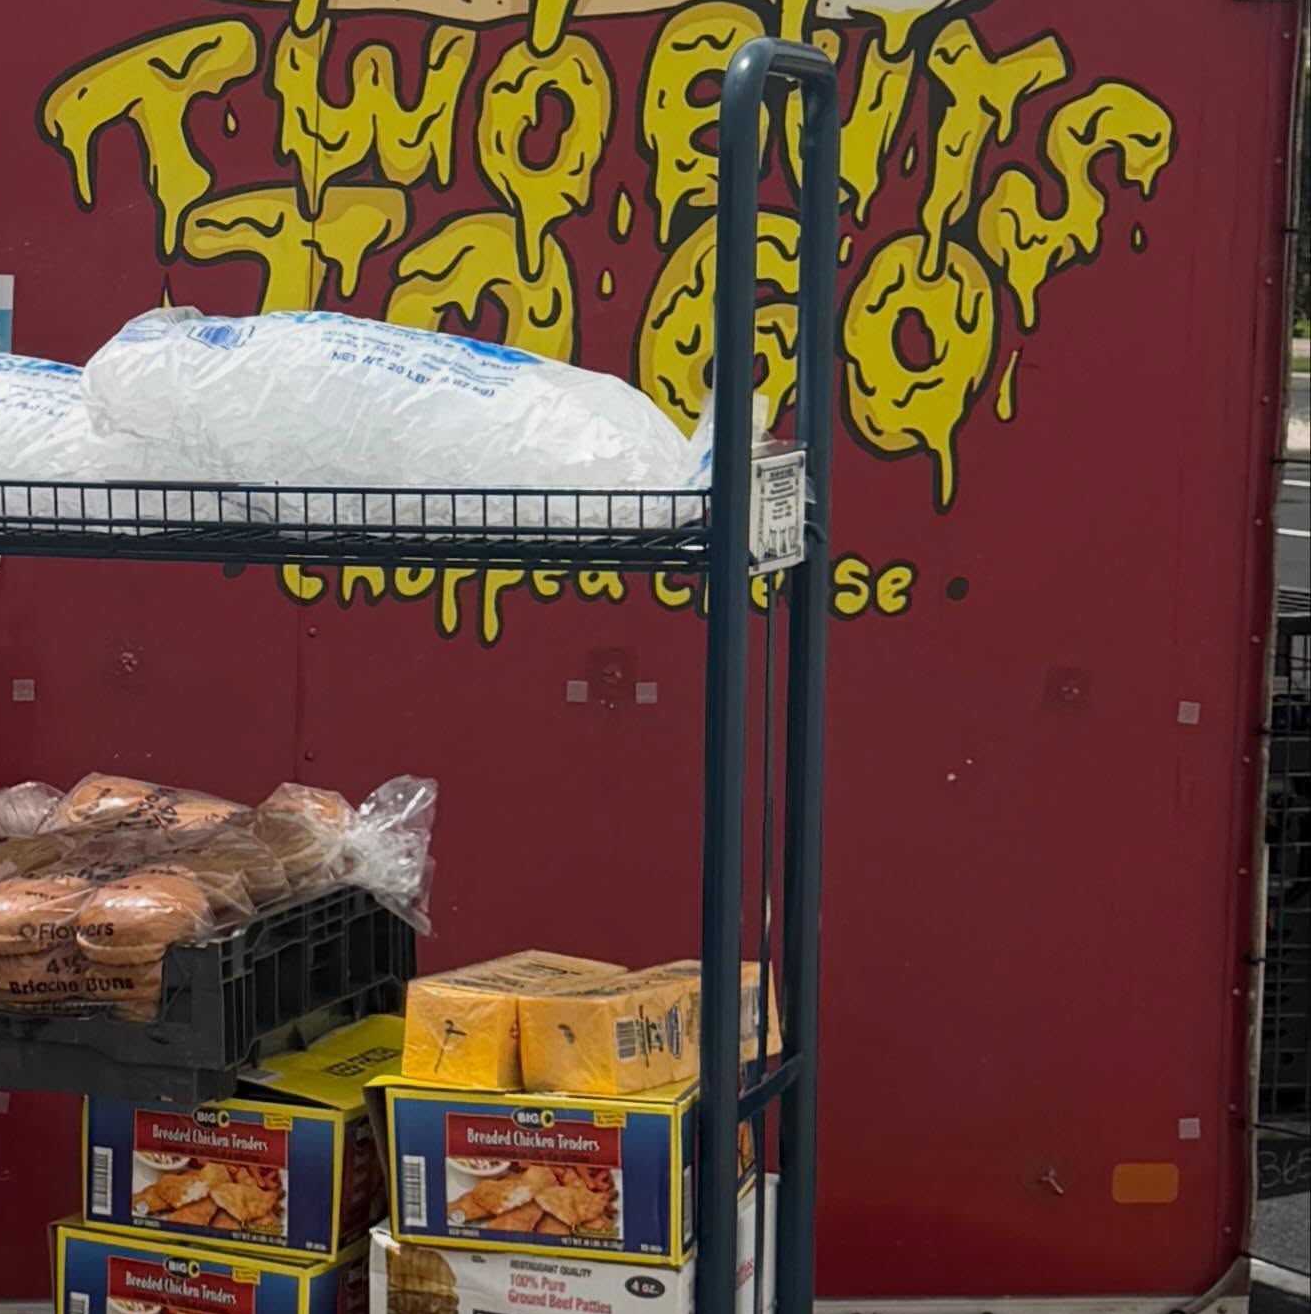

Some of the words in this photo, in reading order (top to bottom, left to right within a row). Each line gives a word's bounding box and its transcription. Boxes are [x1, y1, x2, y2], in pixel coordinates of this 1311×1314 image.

[386, 361, 405, 375] 20
[38, 921, 114, 940] Flowers
[196, 1111, 216, 1123] BIG
[517, 1112, 539, 1124] BIG
[152, 1123, 191, 1143] Breaded
[192, 1129, 229, 1147] Chicken
[230, 1133, 269, 1152] Tenders
[466, 1127, 512, 1145] Breaded
[513, 1132, 555, 1149] Chicken
[557, 1134, 601, 1152] Tenders
[168, 1261, 187, 1274] BIG
[560, 1265, 592, 1278] QUALITY
[125, 1271, 164, 1292] Breaded
[165, 1278, 200, 1298] Chicken
[201, 1284, 238, 1305] Tenders
[510, 1273, 538, 1288] 100%
[541, 1278, 566, 1293] Pure
[630, 1281, 639, 1291] 4
[508, 1289, 547, 1308] Ground
[549, 1294, 573, 1310] Beef
[576, 1298, 613, 1314] Patties
